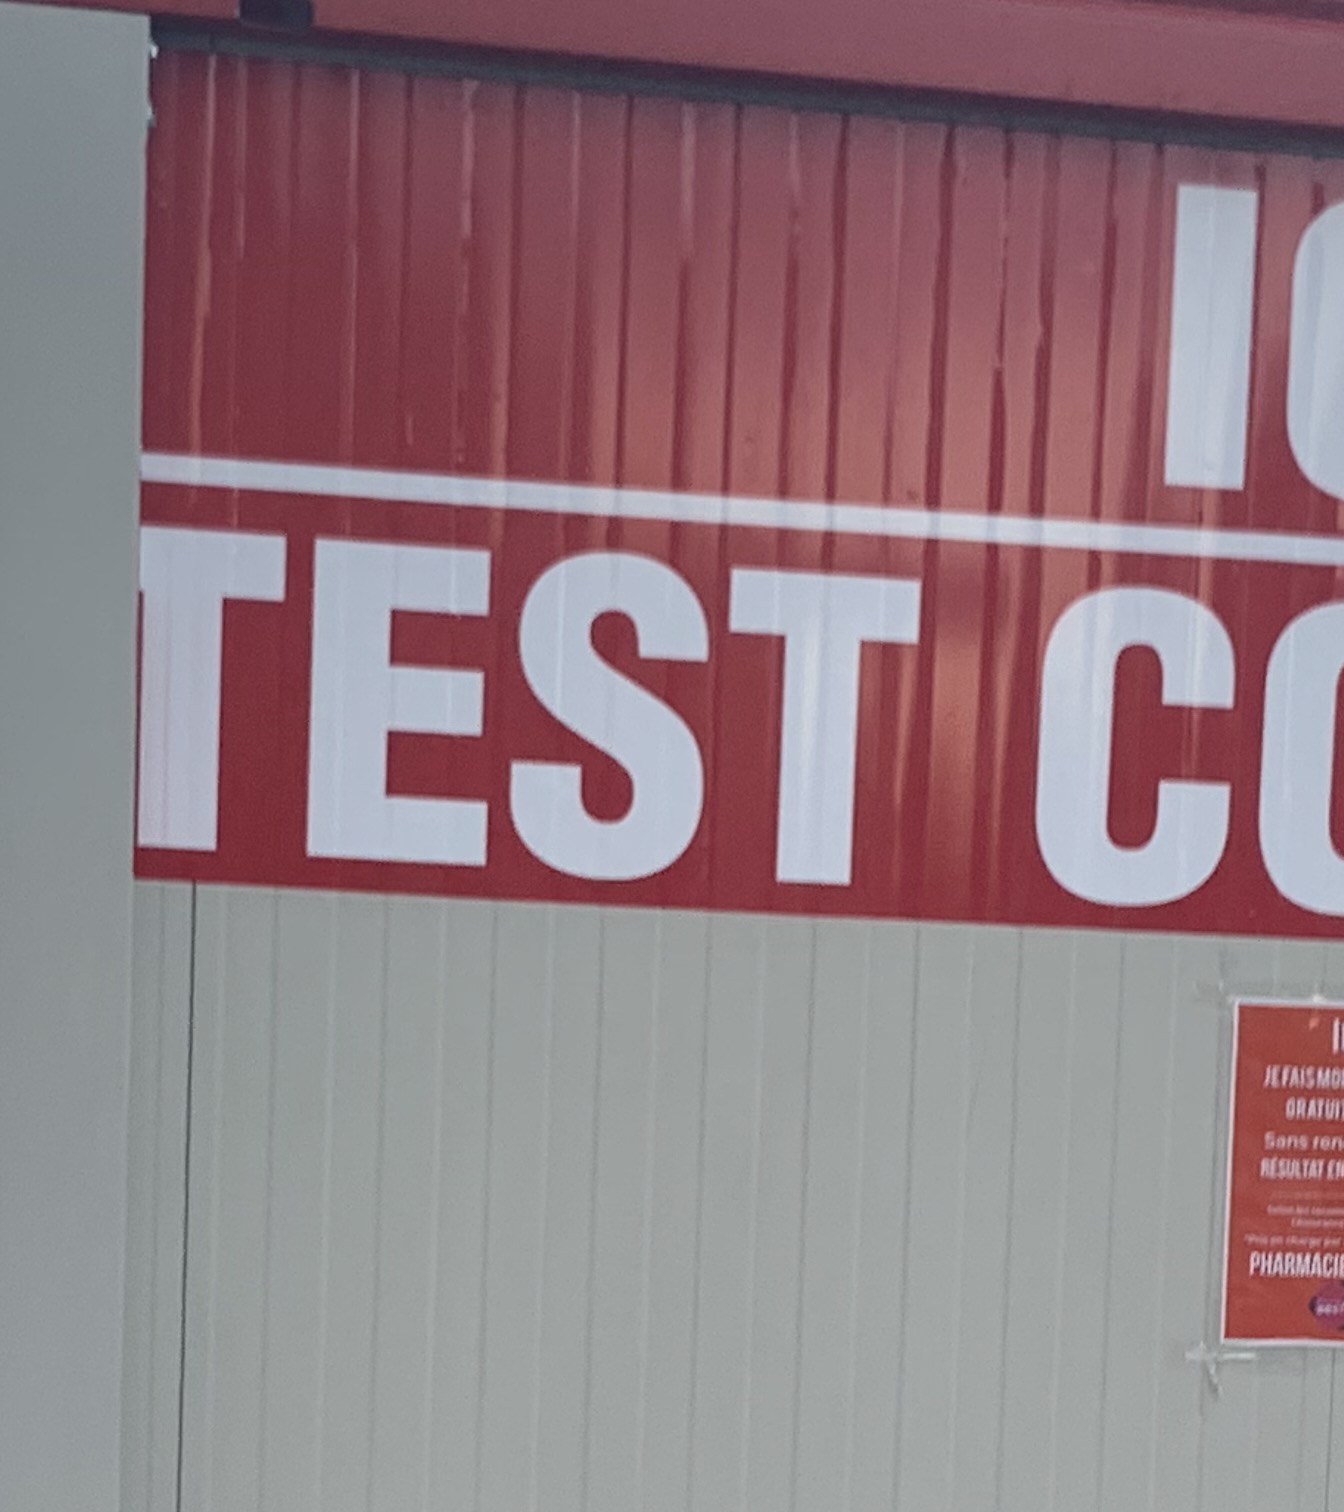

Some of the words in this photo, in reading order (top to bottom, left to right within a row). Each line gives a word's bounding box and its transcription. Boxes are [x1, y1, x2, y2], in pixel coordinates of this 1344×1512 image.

[136, 524, 921, 887] TEST
[1281, 1064, 1316, 1090] FAIS
[1264, 1131, 1307, 1150] Sans
